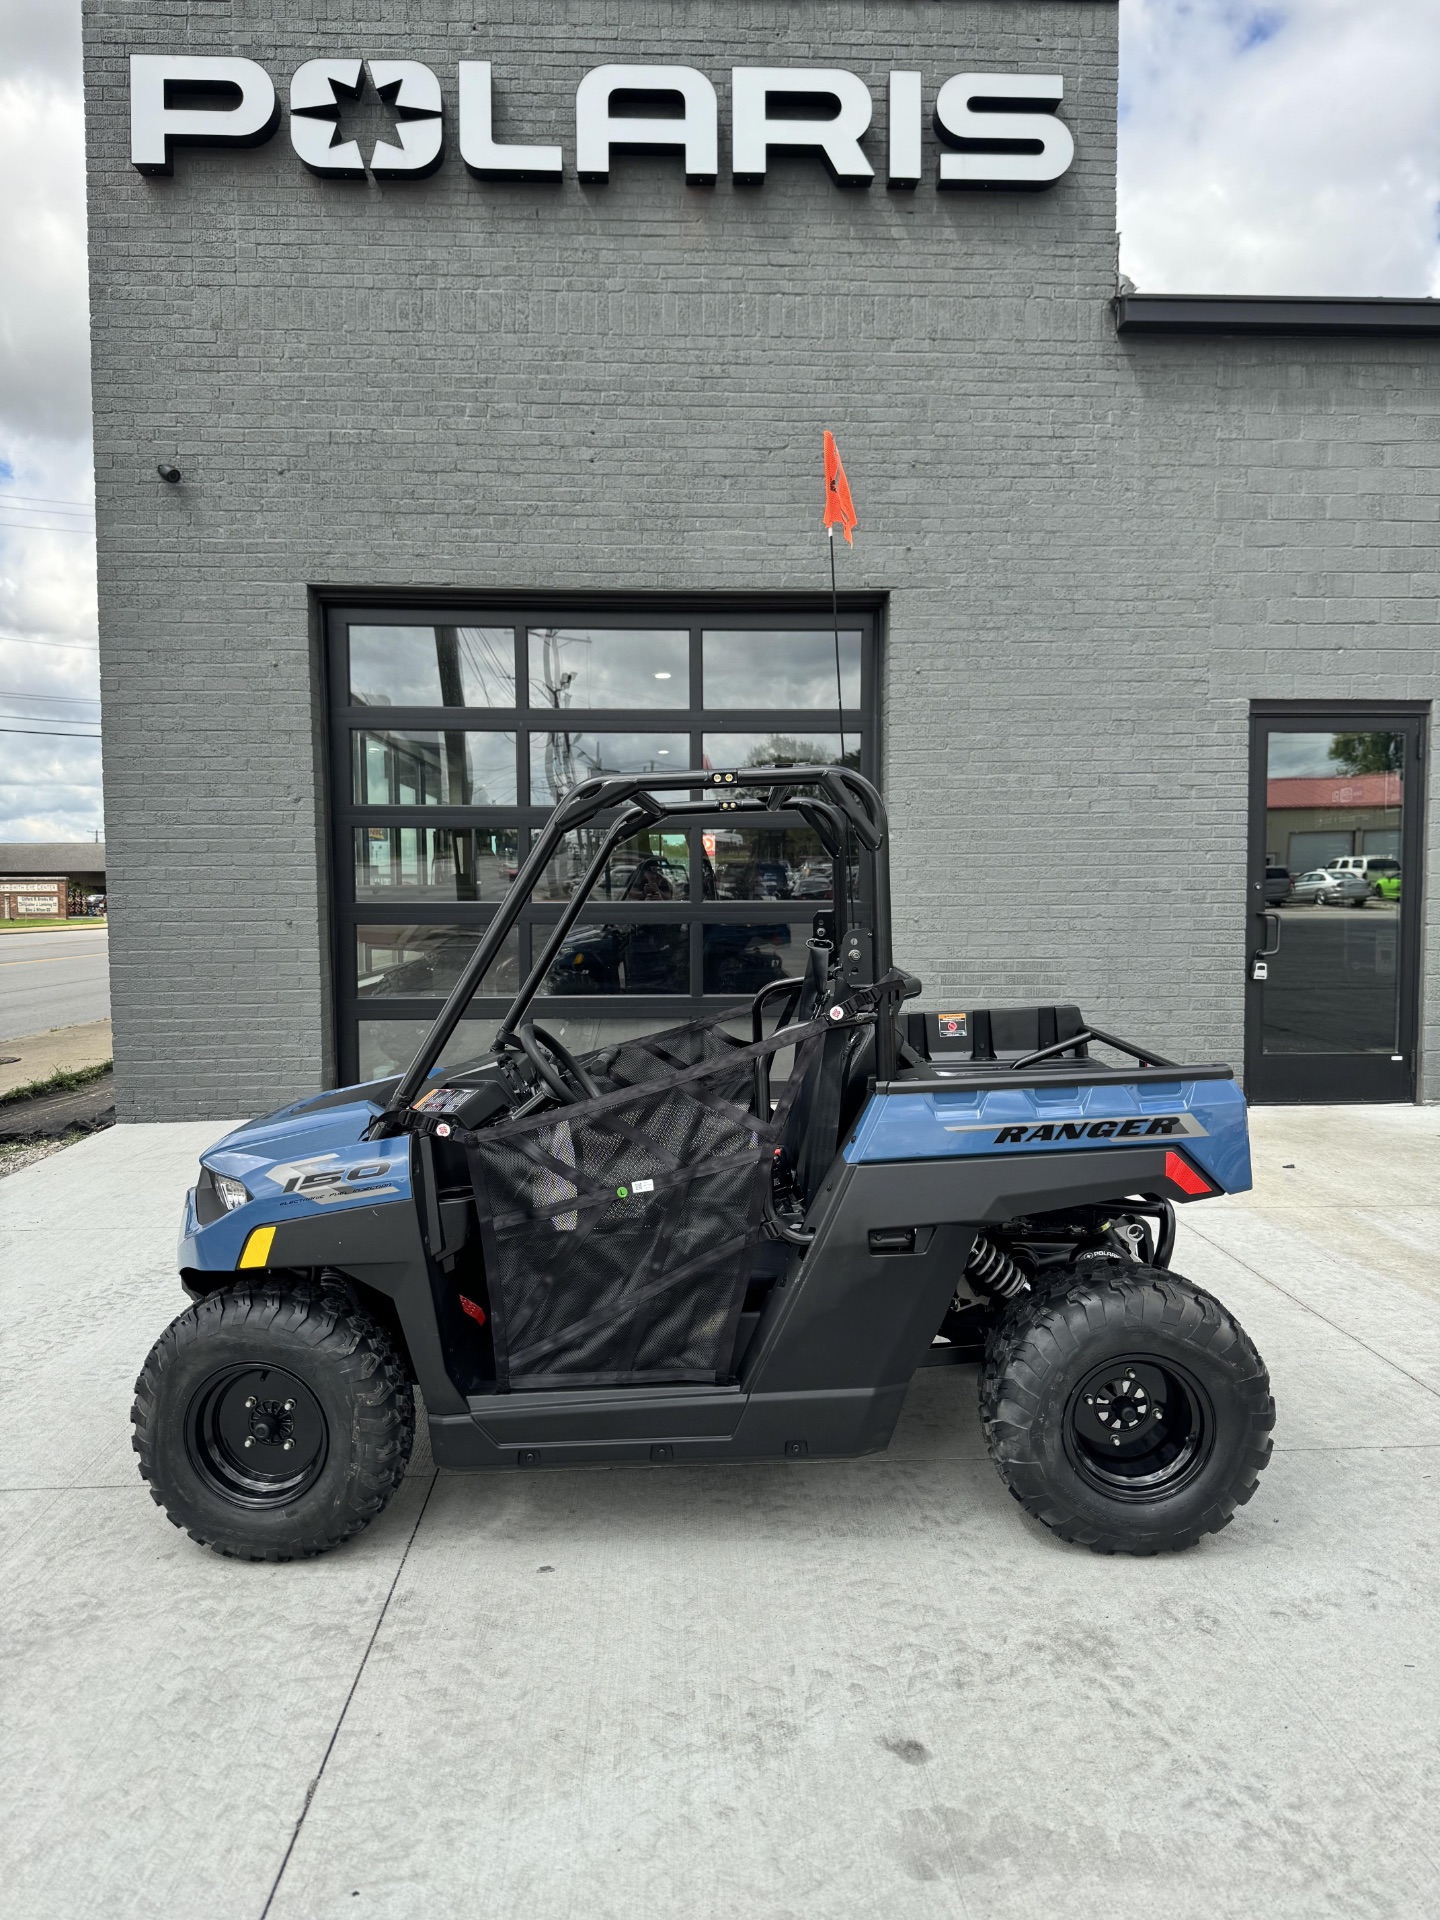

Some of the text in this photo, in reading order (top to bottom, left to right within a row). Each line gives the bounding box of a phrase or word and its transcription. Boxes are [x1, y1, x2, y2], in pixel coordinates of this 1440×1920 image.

[129, 53, 1075, 186] POLARIS
[993, 1116, 1181, 1144] RANGER
[283, 1162, 392, 1194] 150
[279, 1182, 393, 1206] ELECTRONIC FUEL INJECTION
